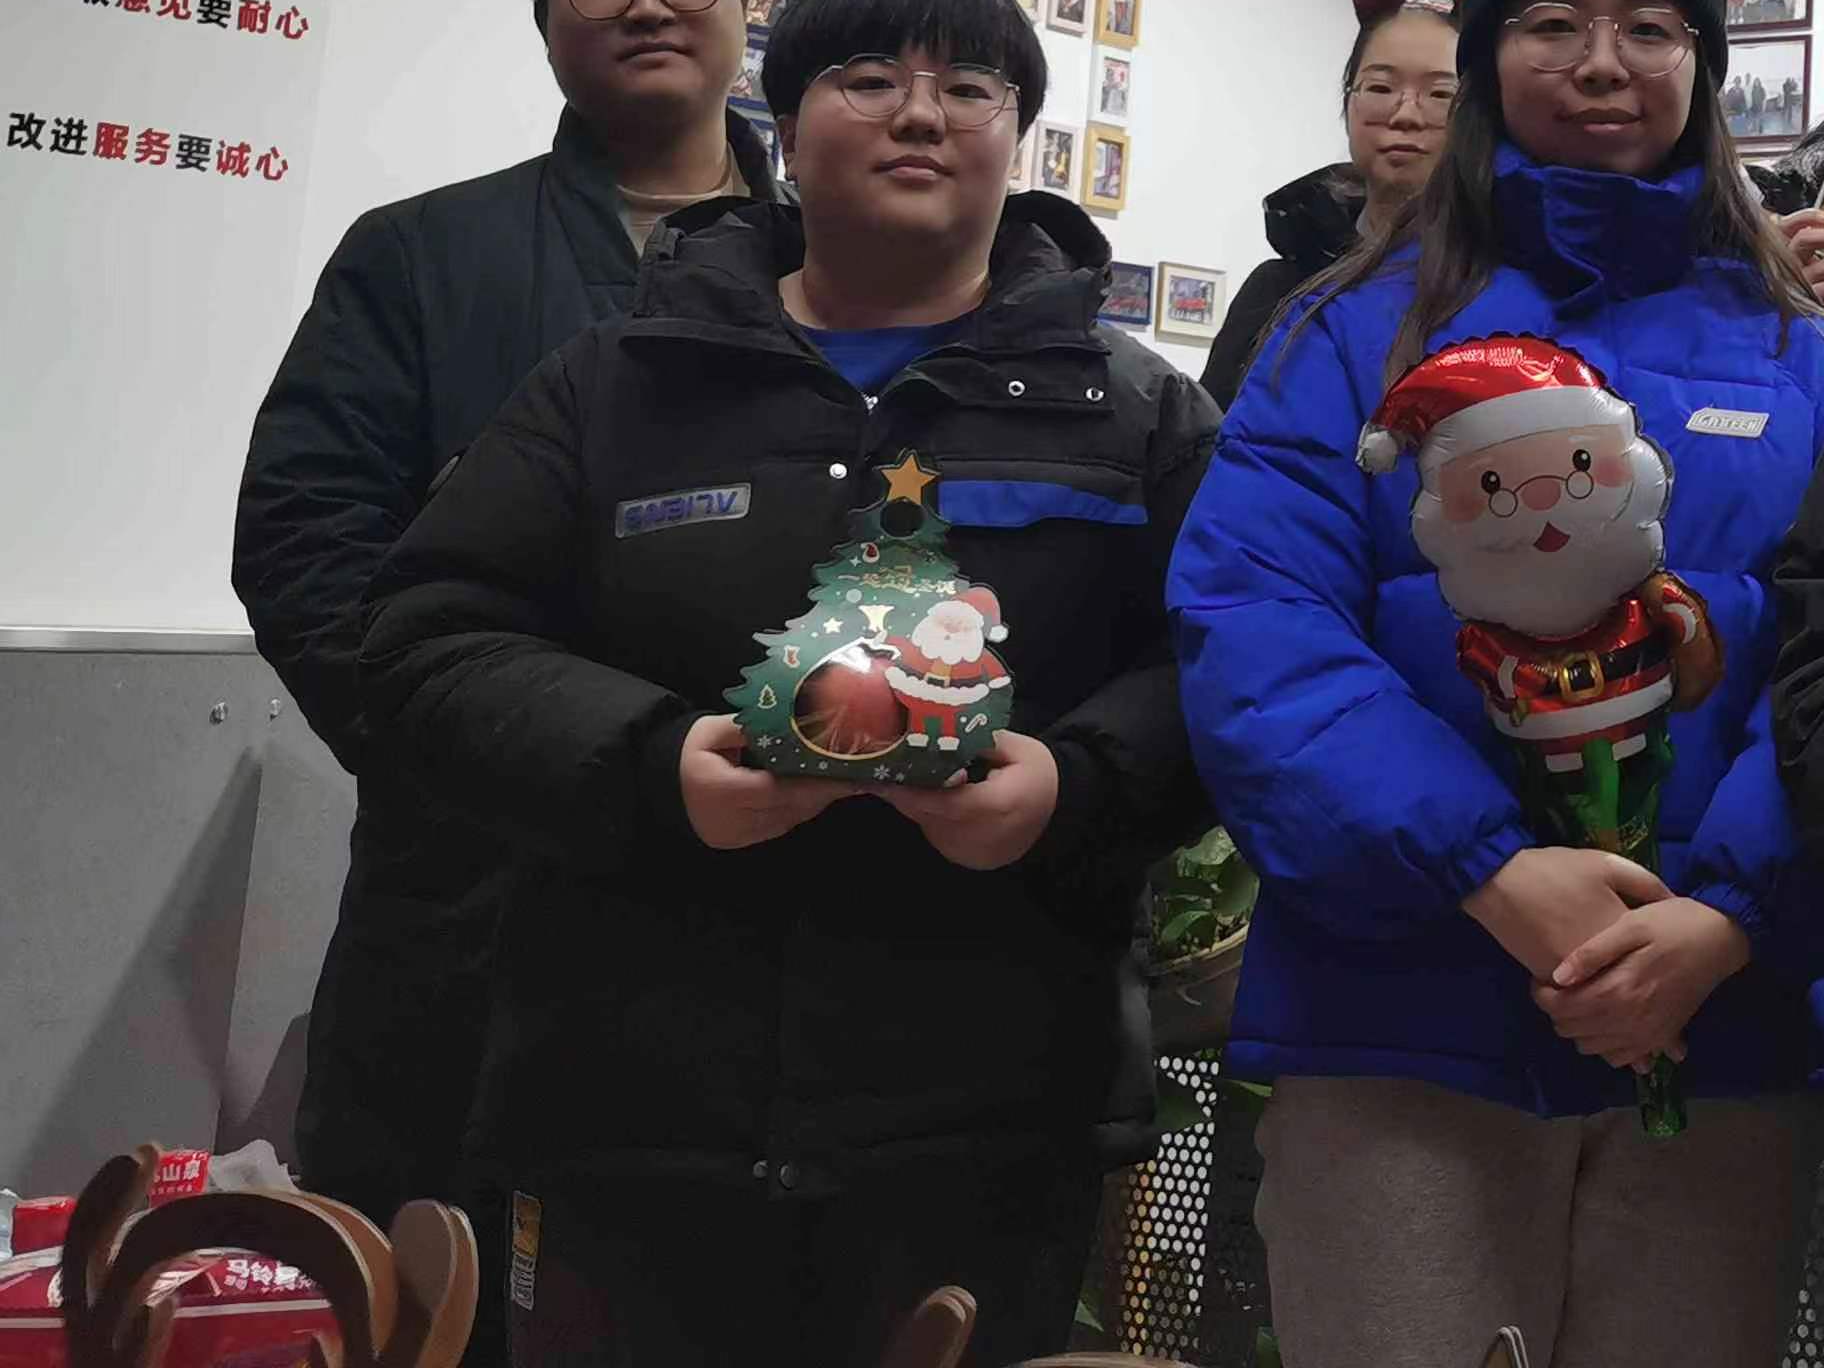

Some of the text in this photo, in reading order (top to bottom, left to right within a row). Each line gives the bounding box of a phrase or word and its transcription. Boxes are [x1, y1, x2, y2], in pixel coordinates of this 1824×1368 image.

[5, 111, 289, 182] 改进服务要诚心
